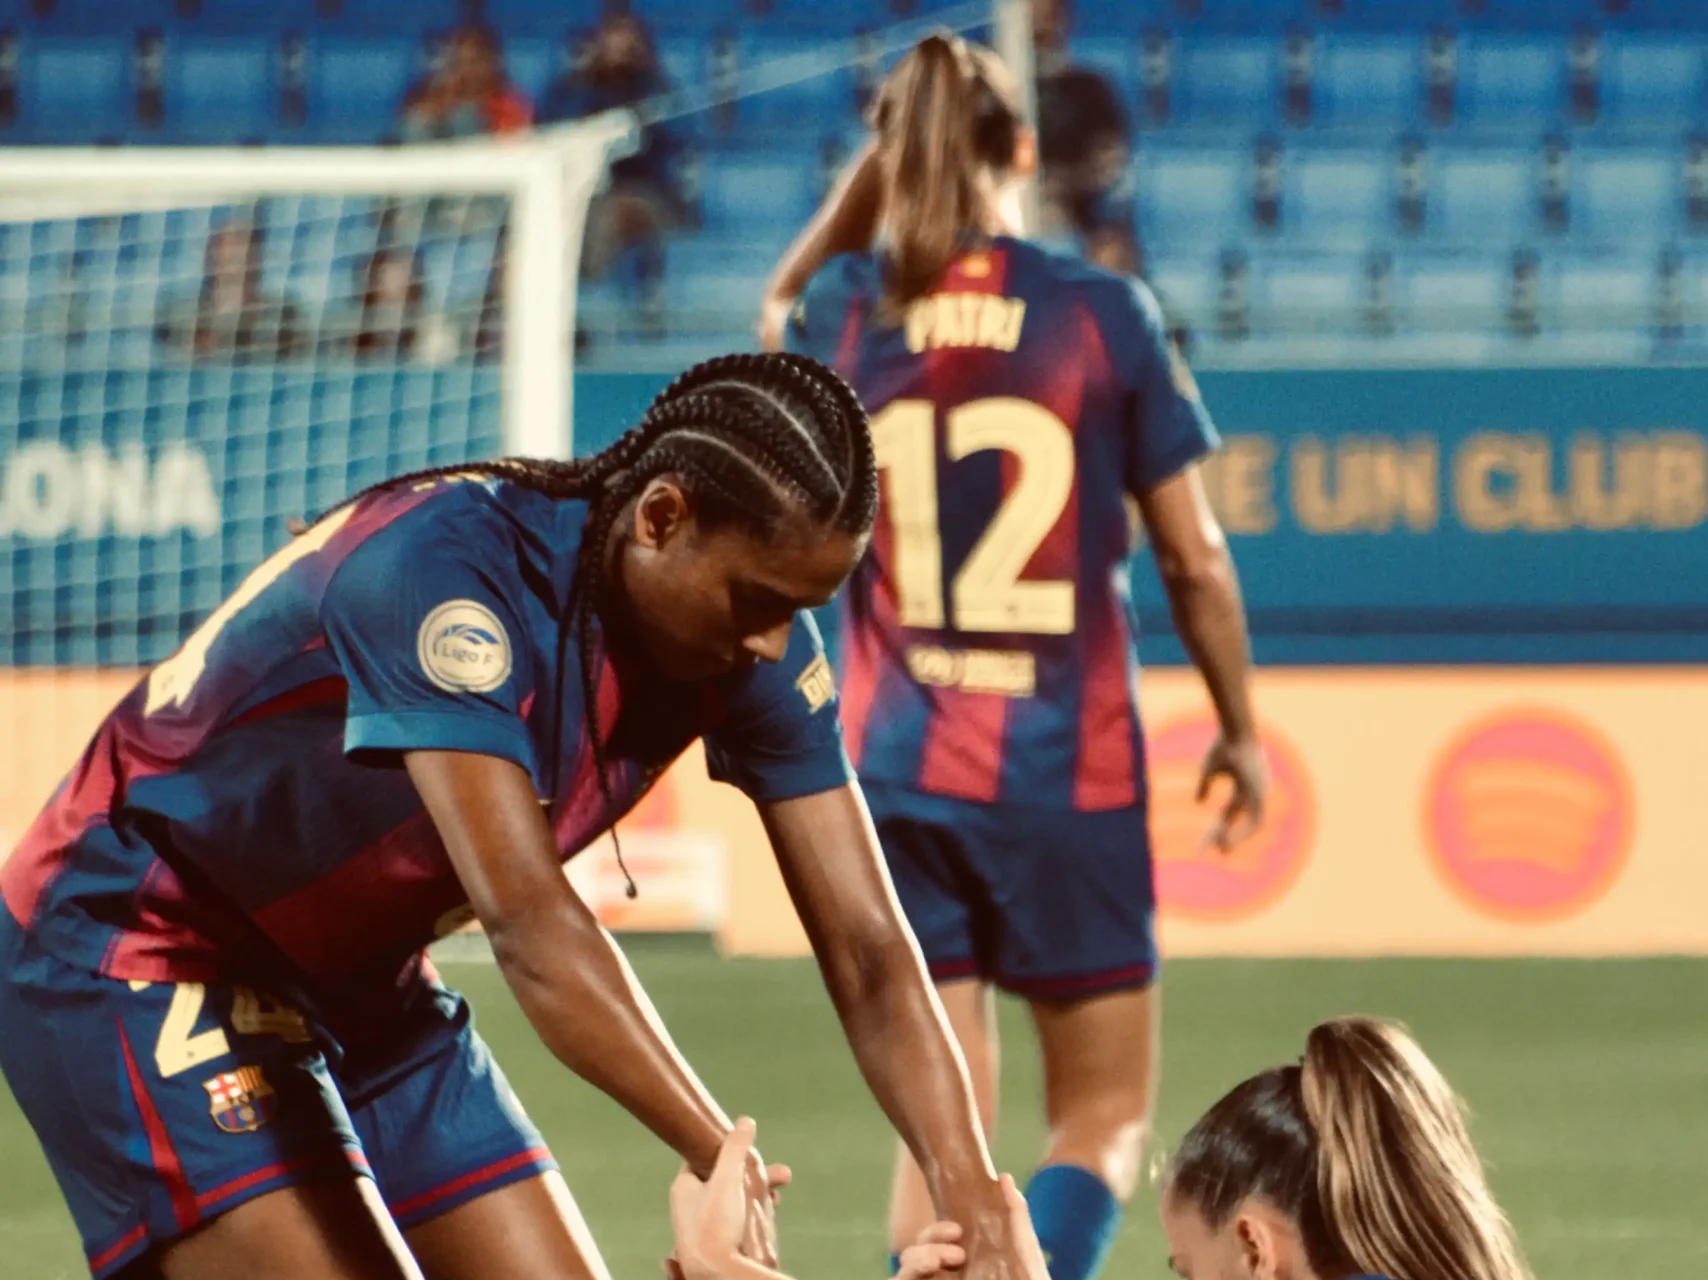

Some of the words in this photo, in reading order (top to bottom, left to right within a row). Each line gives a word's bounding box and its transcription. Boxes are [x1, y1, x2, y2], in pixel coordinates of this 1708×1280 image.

[0, 438, 219, 538] ONA
[871, 397, 1075, 634] 12
[1291, 433, 1439, 534] UN
[1452, 430, 1708, 533] CLUB
